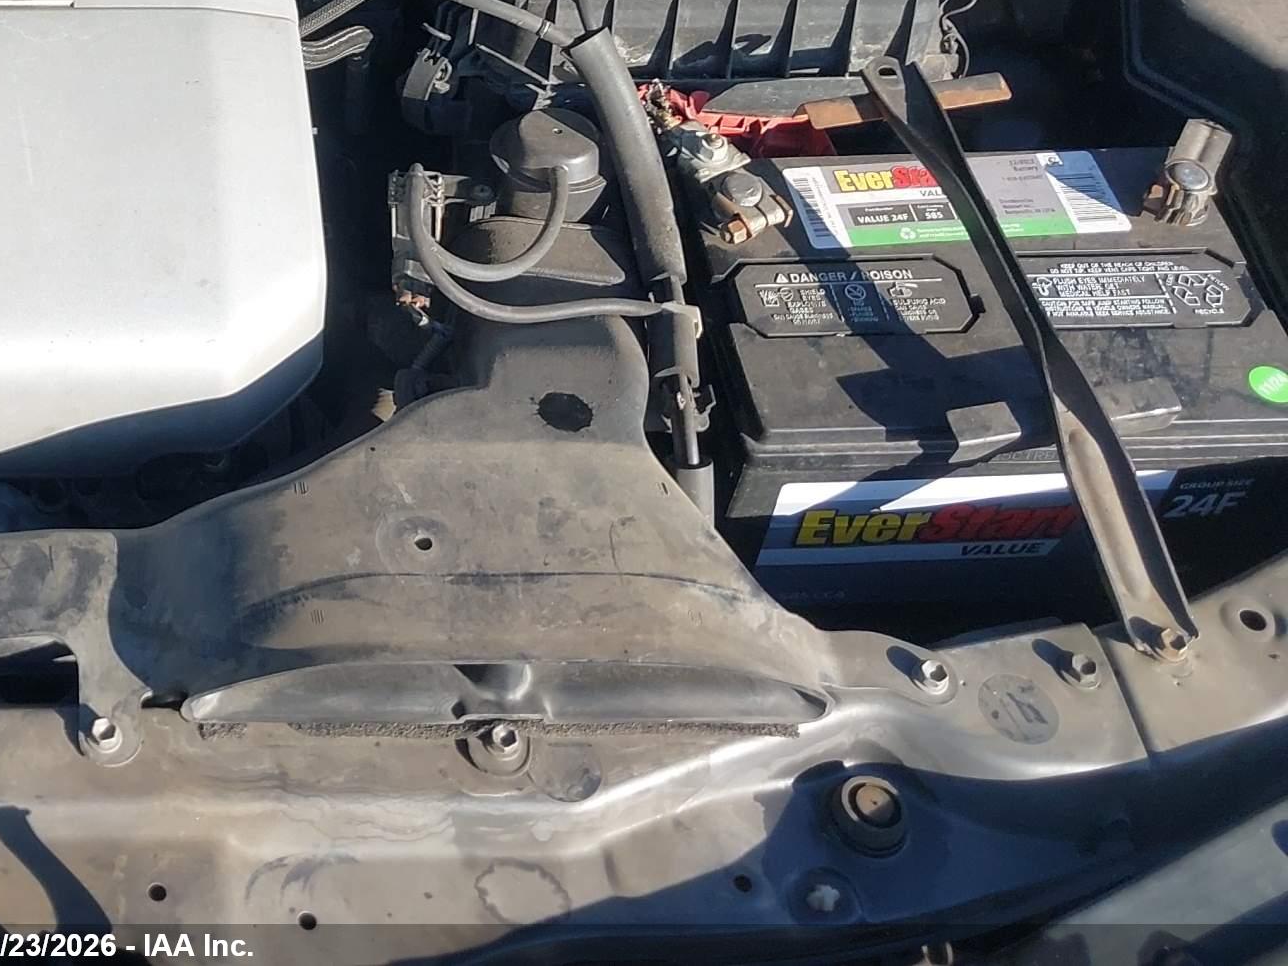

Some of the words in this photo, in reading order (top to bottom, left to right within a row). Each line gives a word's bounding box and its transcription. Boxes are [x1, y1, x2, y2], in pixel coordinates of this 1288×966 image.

[833, 164, 940, 194] EverSta
[857, 214, 890, 223] VALUE
[892, 213, 909, 222] 24F
[925, 212, 944, 220] 585
[791, 272, 847, 283] DANGER
[862, 269, 913, 281] POISON
[1053, 277, 1077, 285] FLUSH
[1078, 276, 1096, 284] EYES
[1098, 275, 1145, 283] IMMEDIATELY
[1180, 481, 1225, 490] GROUP
[1228, 478, 1255, 487] SIZE
[1163, 491, 1246, 518] 24F
[961, 543, 1042, 556] VALUE
